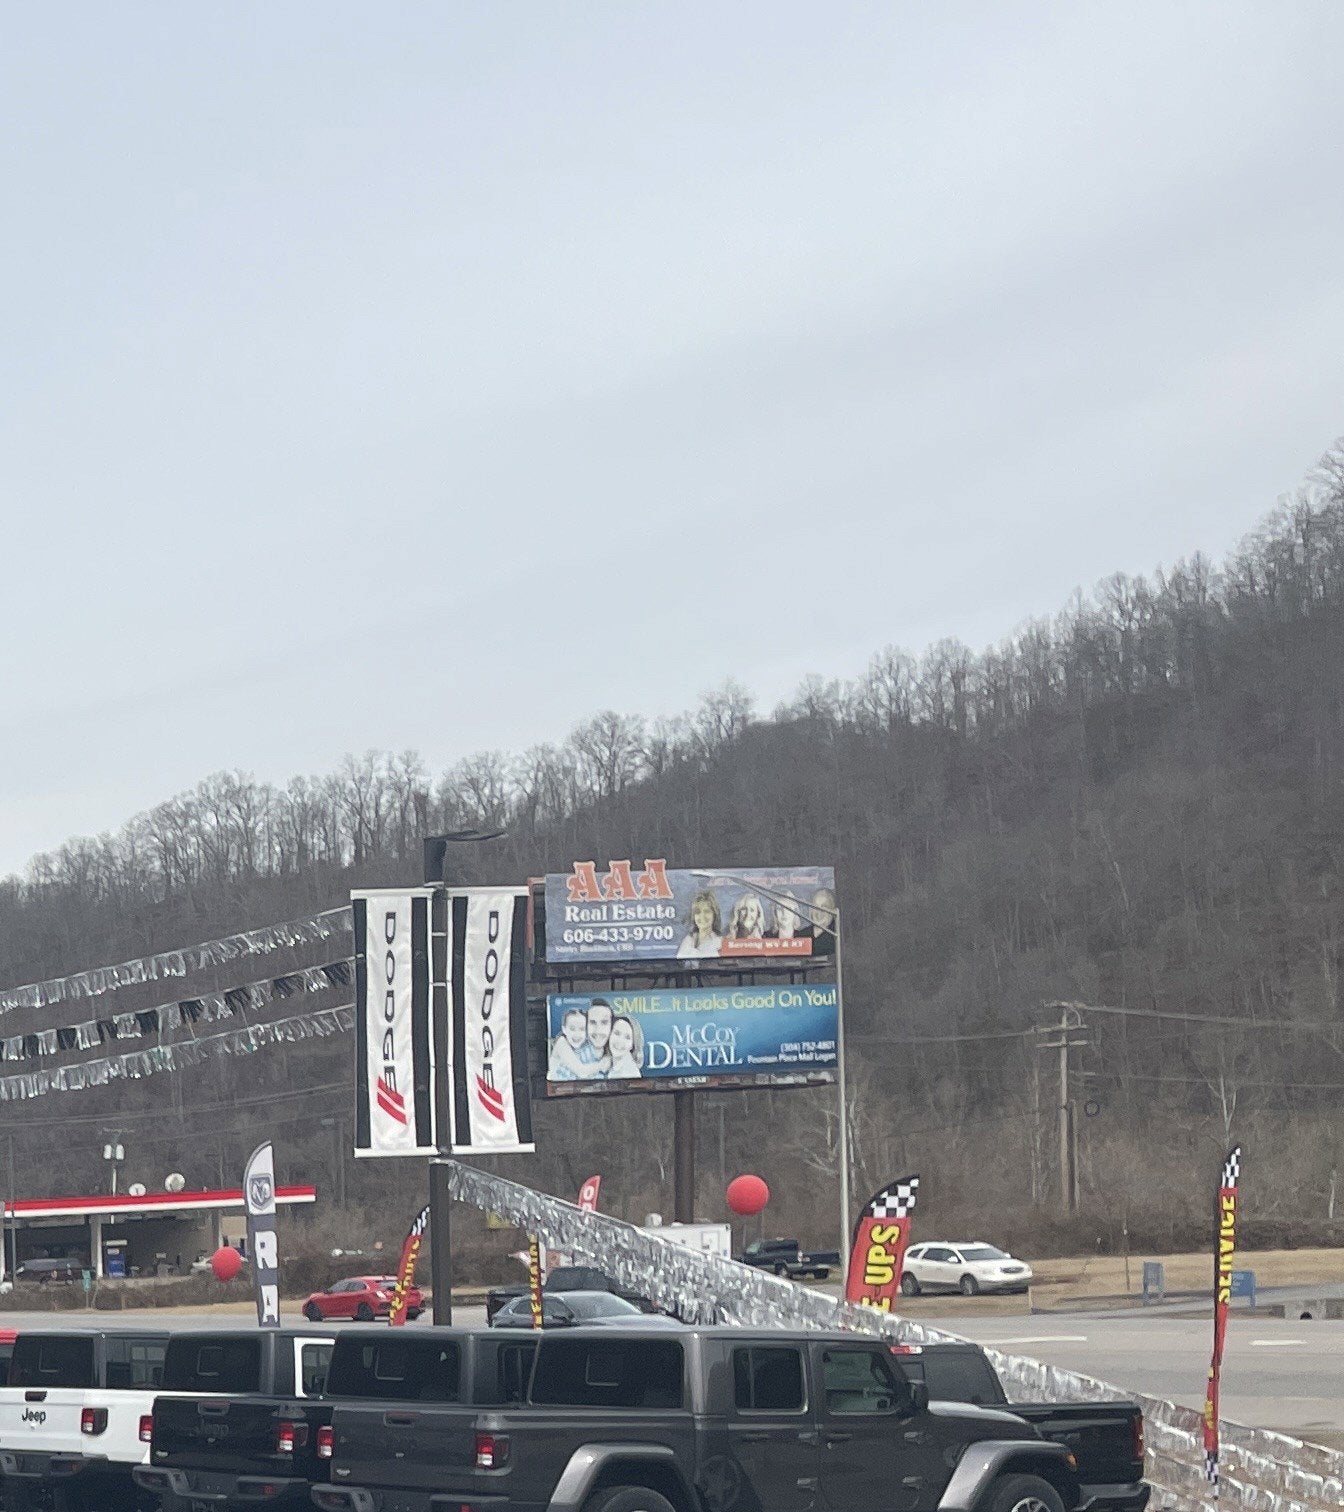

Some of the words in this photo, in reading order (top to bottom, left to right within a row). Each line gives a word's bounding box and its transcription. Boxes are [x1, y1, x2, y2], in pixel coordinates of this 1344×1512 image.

[566, 858, 674, 902] AAA
[565, 904, 608, 922] Real
[612, 903, 676, 920] Estate
[563, 925, 674, 943] 606-433-9700
[382, 911, 397, 1093] DODGE
[481, 911, 500, 1093] DODGE
[685, 993, 729, 1012] Looks
[732, 989, 775, 1010] Good
[778, 990, 802, 1008] On
[803, 988, 837, 1007] You!
[646, 1041, 743, 1069] DENTAL
[21, 1407, 47, 1425] Jeep
